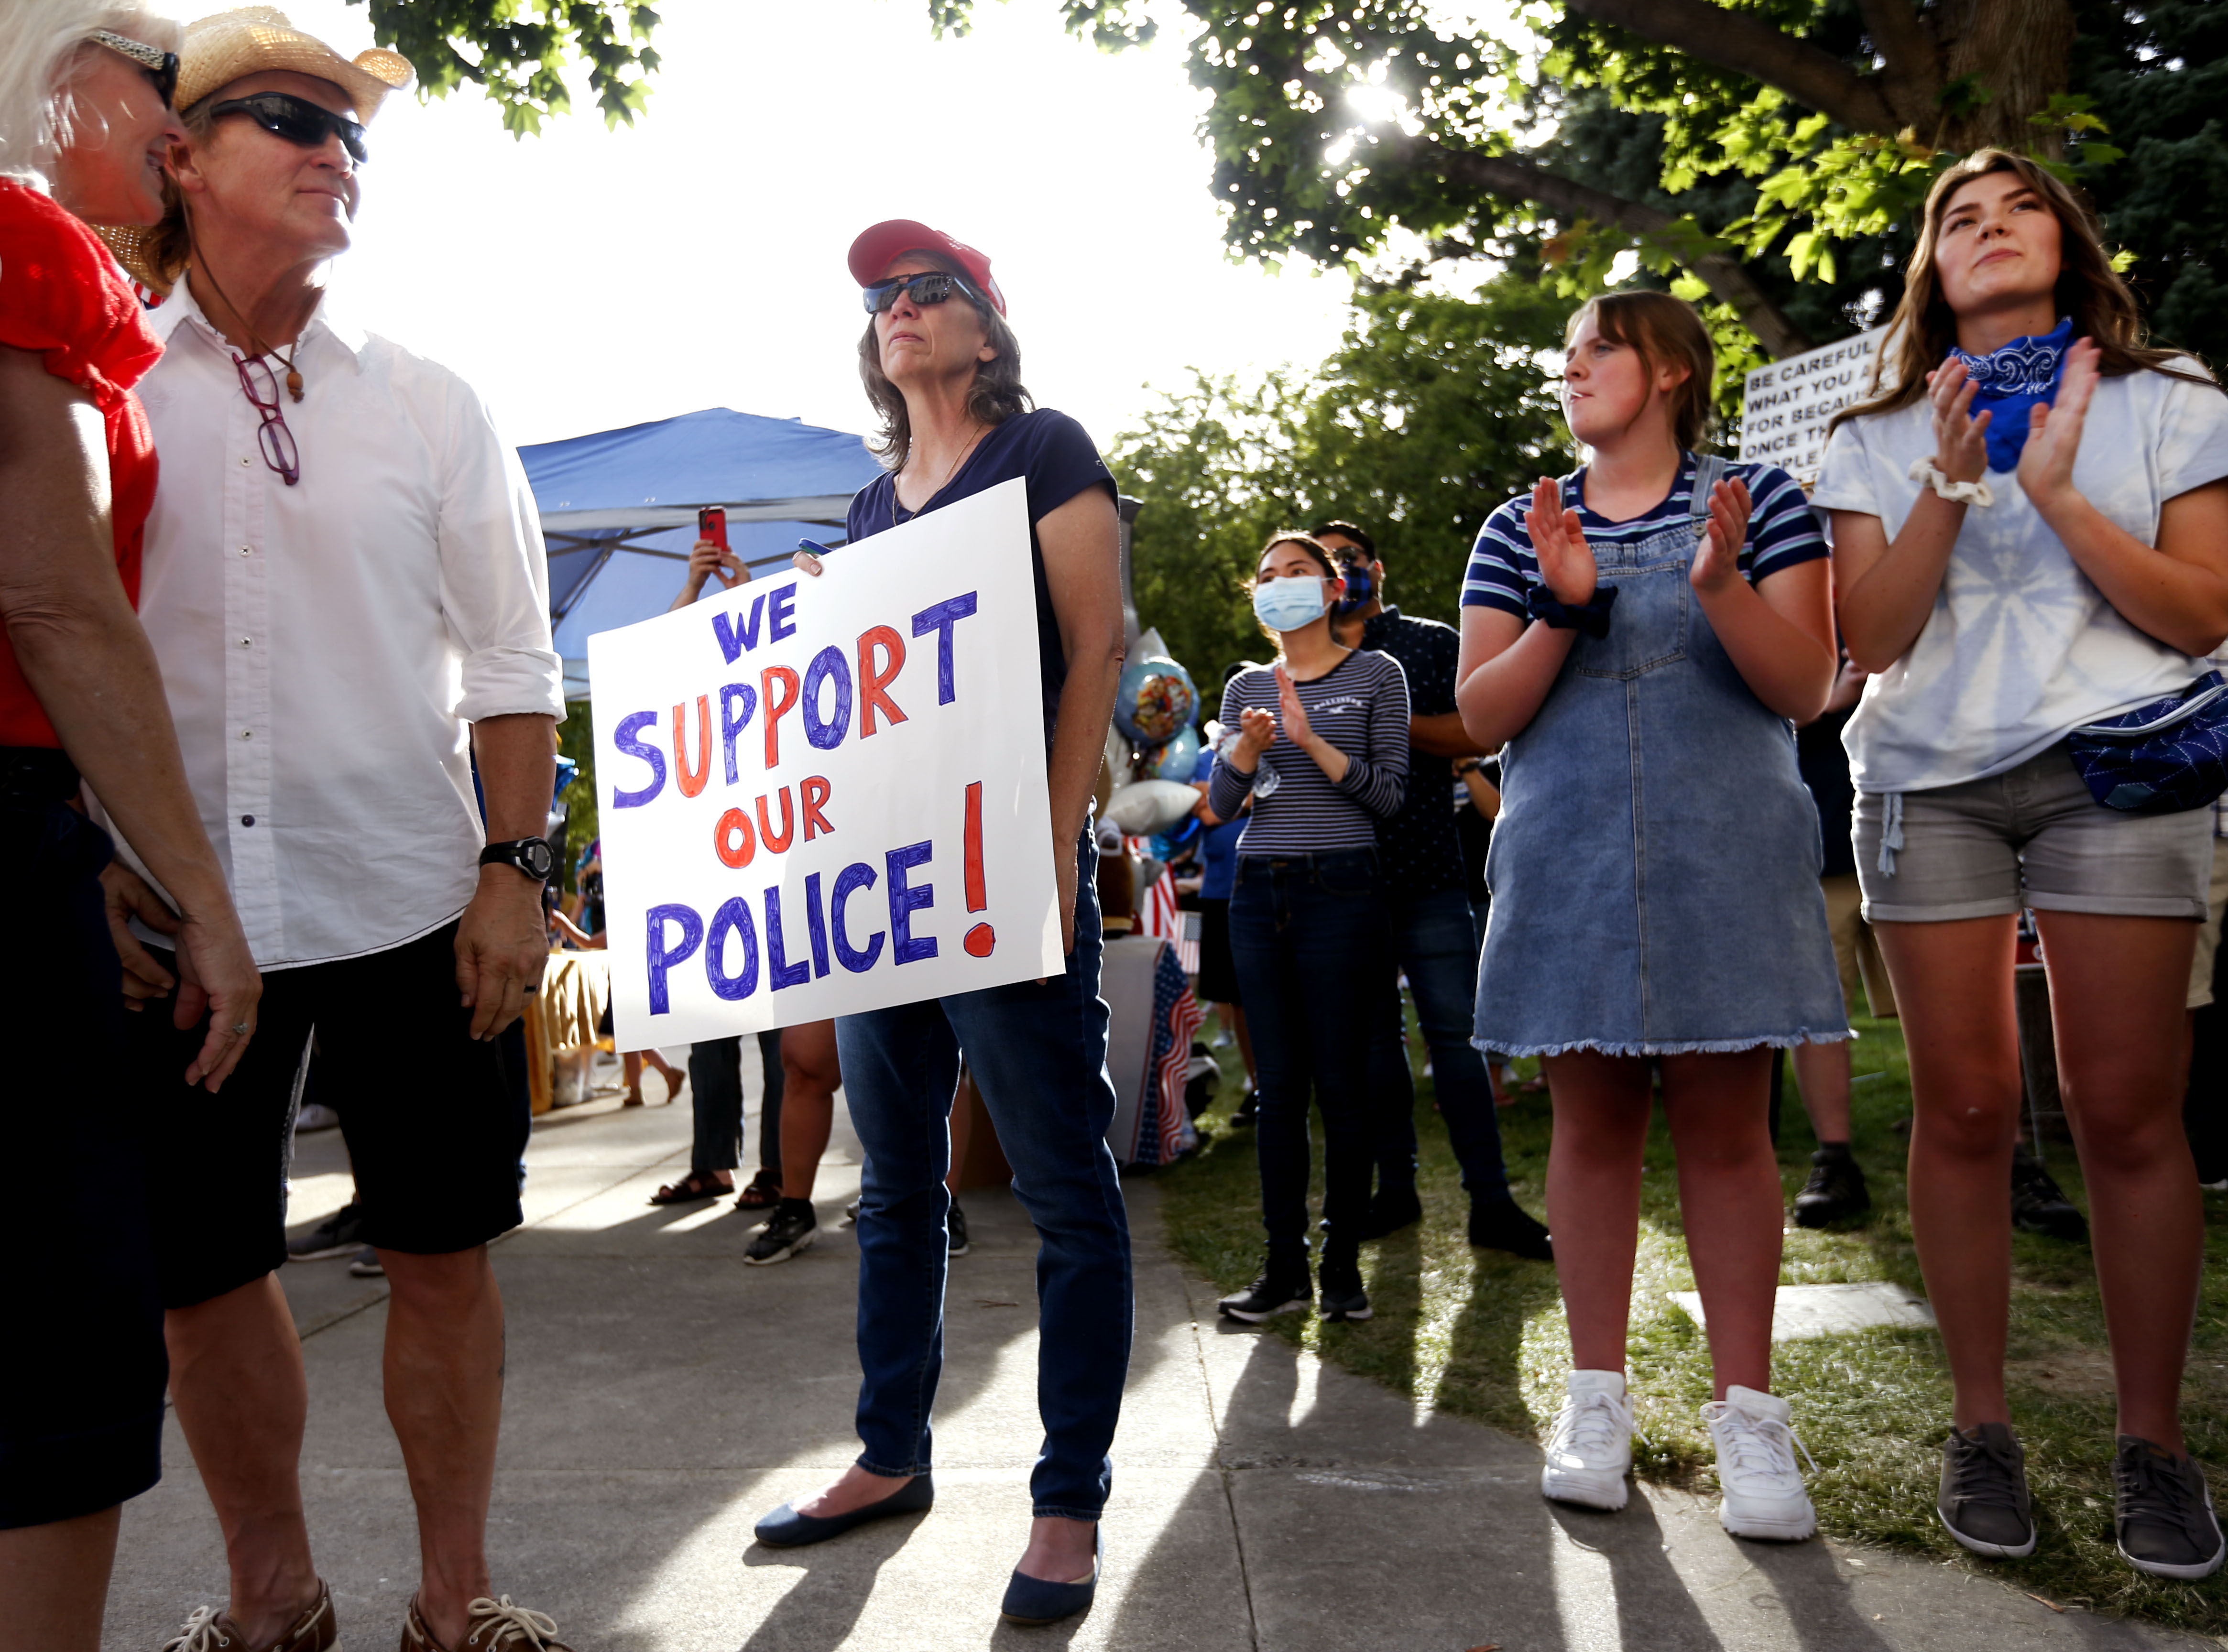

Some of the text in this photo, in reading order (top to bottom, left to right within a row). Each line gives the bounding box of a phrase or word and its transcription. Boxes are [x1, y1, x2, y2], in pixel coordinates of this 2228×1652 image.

[1749, 373, 1774, 391] BE
[1780, 341, 1874, 381] CAREFUL
[1746, 390, 1866, 436] FOR BECAU
[1748, 386, 1802, 413] WHAT
[1811, 370, 1852, 391] YOU
[1745, 432, 1798, 458] ONCE
[712, 582, 797, 665] WE
[613, 590, 978, 809] SUPPORT
[714, 775, 835, 869] OUR
